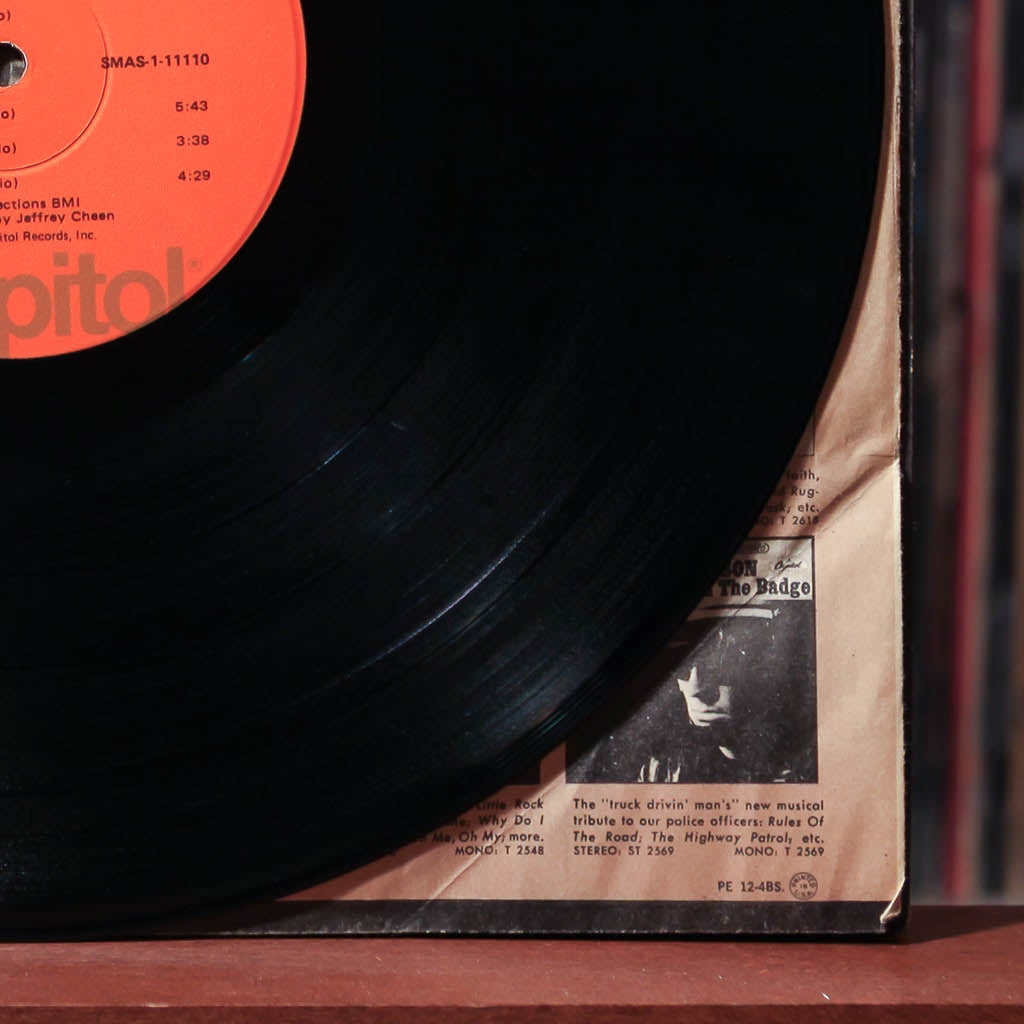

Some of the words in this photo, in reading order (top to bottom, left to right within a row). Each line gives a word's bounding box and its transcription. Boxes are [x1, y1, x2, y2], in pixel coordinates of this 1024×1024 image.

[101, 52, 209, 69] SMAS-1-11110
[176, 101, 208, 112] 5:43
[177, 135, 209, 146] 3:38
[178, 170, 210, 181] 4:29
[52, 197, 79, 208] BMI
[17, 212, 65, 224] Jeffrey
[72, 211, 114, 222] Cheen
[23, 231, 71, 242] Records,
[77, 230, 96, 240] Inc.
[791, 489, 819, 498] Rug-
[798, 503, 819, 512] etc.
[722, 579, 751, 596] The
[757, 577, 810, 598] Badge
[514, 798, 543, 809] Rock
[573, 798, 595, 809] The
[602, 799, 640, 809] "truck
[647, 799, 688, 809] drivin'
[777, 800, 823, 811] musical
[479, 817, 507, 828] Why
[514, 815, 531, 825] Do
[574, 815, 616, 826] tribute
[622, 816, 633, 826] to
[640, 818, 659, 826] our
[667, 816, 704, 828] police
[710, 815, 762, 827] officers:
[768, 816, 801, 827] Rules
[808, 816, 824, 827] Of
[458, 829, 477, 842] Oh
[482, 830, 505, 844] My;
[574, 831, 595, 842] The
[606, 831, 641, 843] Road;
[652, 832, 674, 842] The
[685, 831, 741, 845] Highway
[802, 834, 824, 843] etc.
[456, 845, 497, 856] MONO:
[517, 845, 543, 855] 2548
[574, 846, 620, 855] STEREO:
[629, 846, 640, 855] ST
[648, 846, 674, 856] 2569
[735, 847, 777, 856] MONO:
[797, 847, 824, 856] 2569
[718, 881, 732, 892] PE
[741, 881, 784, 892] 12-4BS.
